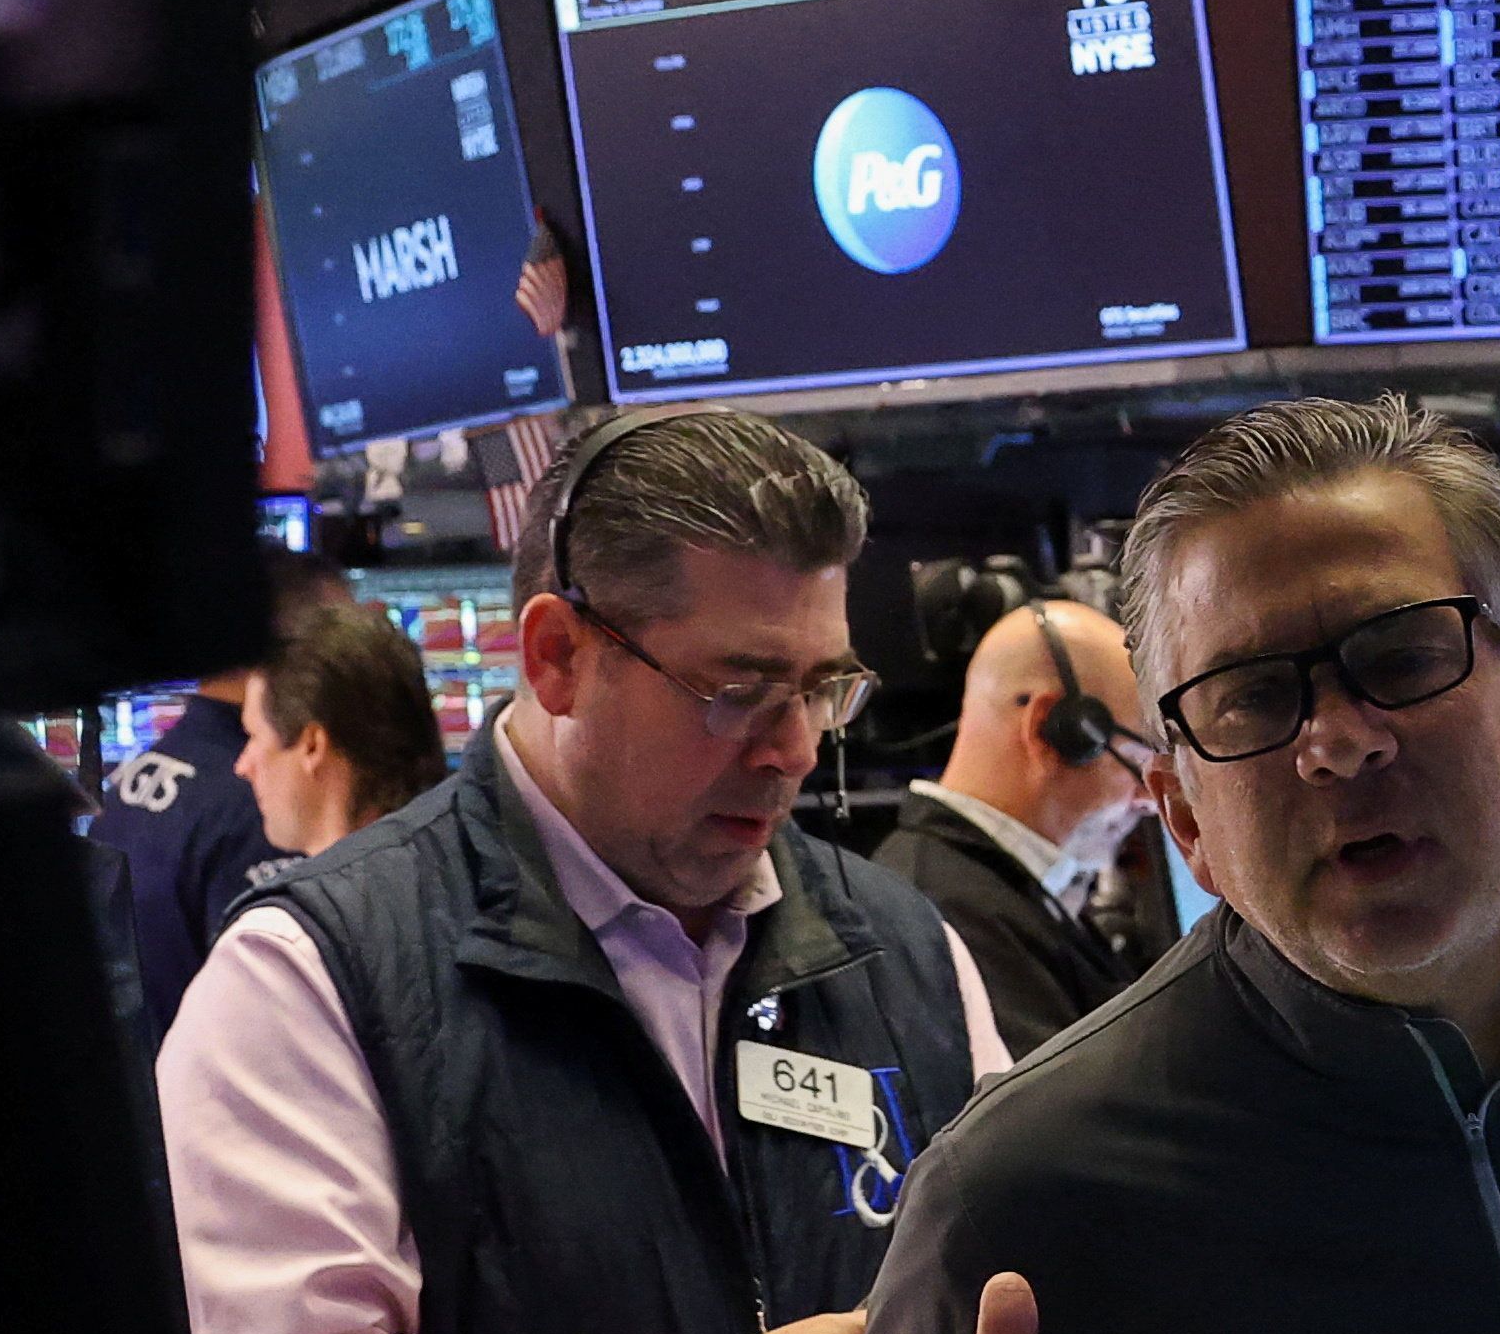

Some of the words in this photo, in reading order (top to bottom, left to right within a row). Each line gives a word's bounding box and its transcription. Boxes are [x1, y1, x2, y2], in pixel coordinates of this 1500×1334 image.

[1070, 33, 1156, 75] NYSE
[847, 144, 943, 214] P&G
[352, 214, 459, 303] MARSH
[772, 1059, 838, 1104] 641
